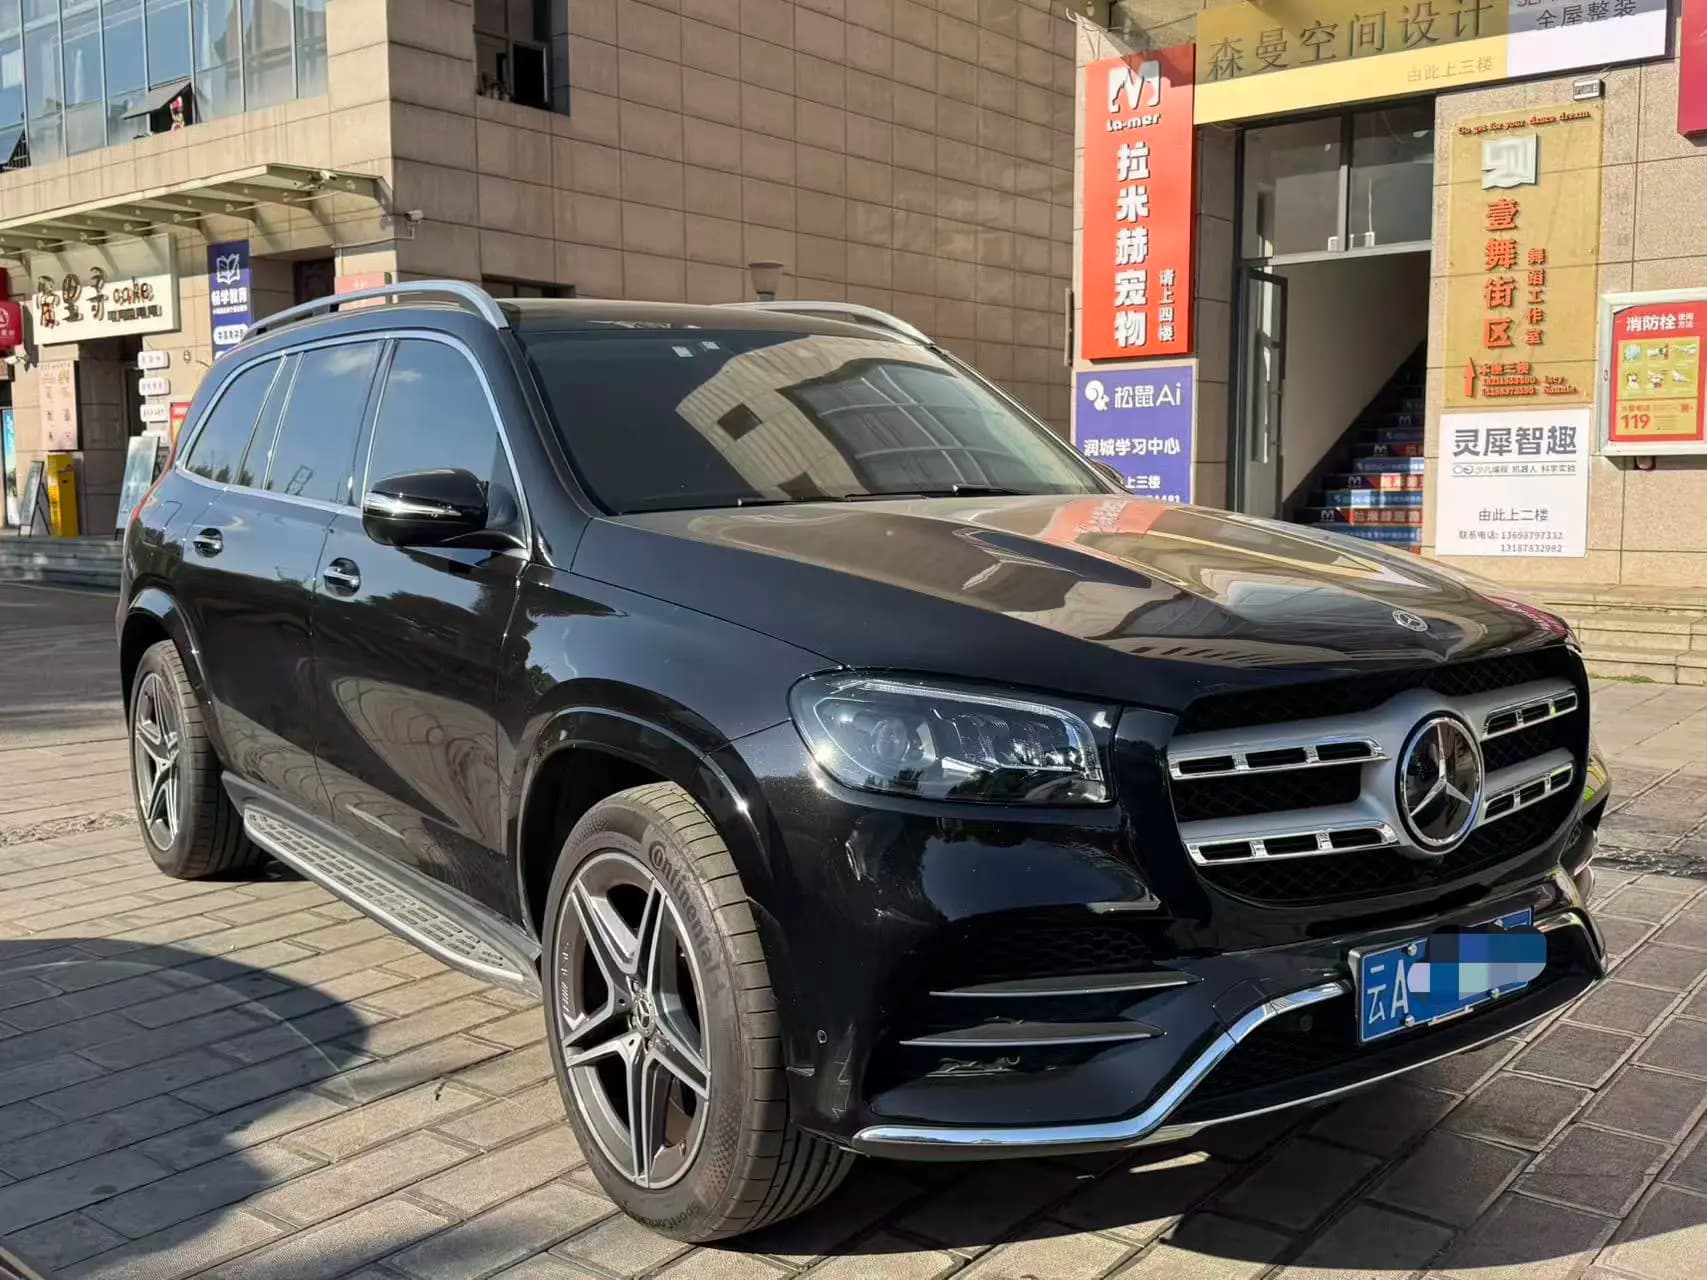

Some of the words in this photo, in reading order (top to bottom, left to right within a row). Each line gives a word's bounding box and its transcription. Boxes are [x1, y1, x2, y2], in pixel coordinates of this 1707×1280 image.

[1208, 0, 1493, 80] 森曼空间设计
[1408, 56, 1494, 81] 由此上三楼
[1114, 141, 1149, 348] 拉米赫宠物
[1484, 199, 1518, 349] 壹舞街区
[1159, 269, 1175, 342] 请上四楼
[1527, 248, 1545, 345] 舞蹈工作室
[1626, 313, 1677, 332] 消防栓
[1621, 413, 1650, 429] 119
[1083, 437, 1180, 457] 润城学习中心
[1453, 425, 1577, 457] 灵犀智趣
[1512, 465, 1537, 473] 机器人
[1541, 464, 1576, 473] 科学实验
[1479, 507, 1549, 522] 由此上二楼
